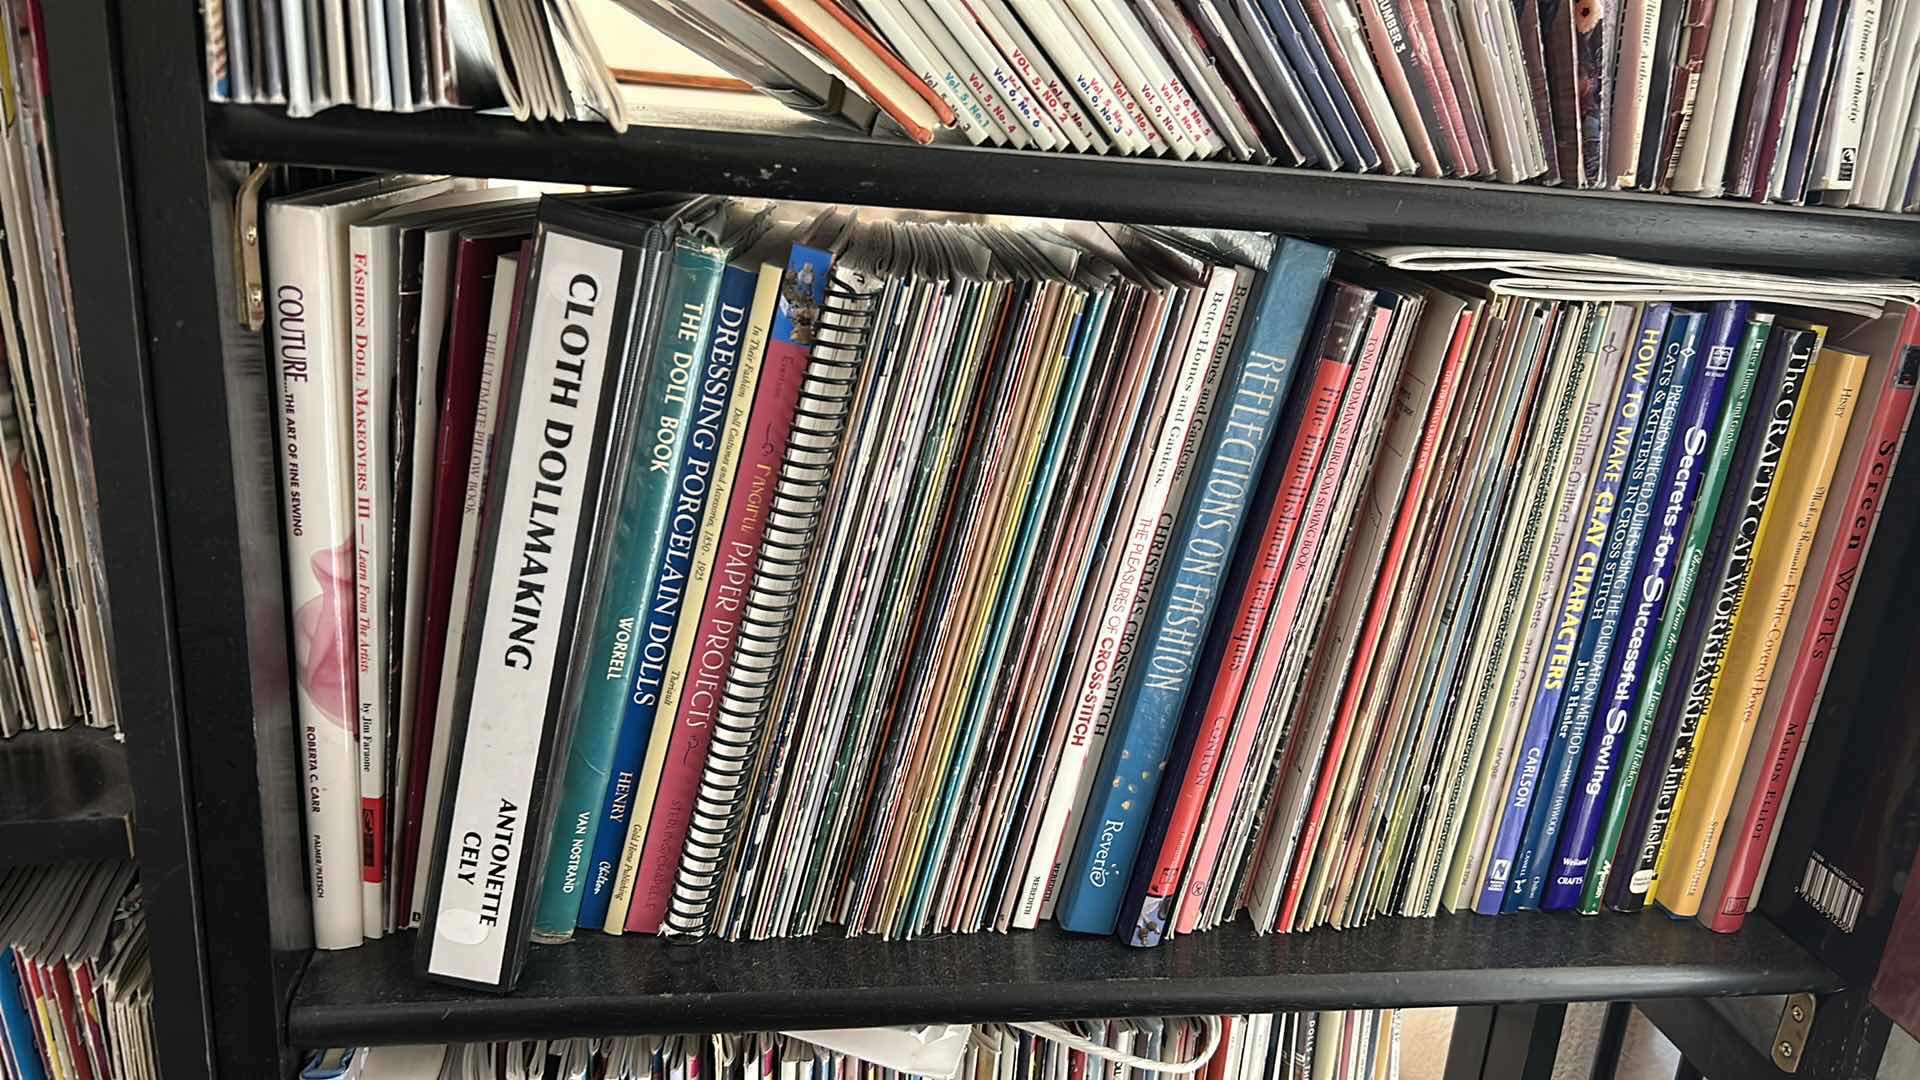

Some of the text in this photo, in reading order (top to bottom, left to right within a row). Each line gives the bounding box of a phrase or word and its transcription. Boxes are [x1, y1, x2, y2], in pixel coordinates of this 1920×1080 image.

[1394, 43, 1406, 53] 3
[1847, 9, 1874, 123] Ultimate Authority
[967, 72, 1017, 133] Vol. 5, No. 4
[991, 66, 1011, 89] Vol.
[1017, 99, 1034, 119] No.
[1011, 48, 1068, 122] VOL. 5, NO. 2
[1200, 290, 1224, 338] Better
[1223, 285, 1247, 332] Better
[648, 300, 704, 474] THE DOLL BOOK
[1183, 339, 1208, 392] Homes
[1205, 332, 1232, 386] Homes
[1780, 344, 1811, 397] The
[286, 417, 296, 436] ART
[1173, 395, 1191, 423] and
[1195, 387, 1214, 416] and
[288, 440, 298, 459] OF
[289, 463, 299, 487] FINE
[354, 253, 370, 672] FASHION DOLL MAKEOVERS III Learn From The Artists
[502, 272, 599, 672] CLOTH DOLLMAKING
[693, 325, 762, 581] In Their Fashion Doll Costumes and Accessories, 1925
[1295, 335, 1378, 571] TONIA TODMAN'S HEIRLOOM SEWING BOOK
[1745, 396, 1794, 512] CRAFTY
[631, 302, 745, 707] DRESSING PORCELAIN DOLLS
[1542, 326, 1661, 692] HOW TO MAKE CLAY CHARACTERS
[1590, 340, 1680, 622] CATS & KITTENS IN CROSS STITCH
[1798, 484, 1826, 530] Making
[290, 491, 302, 536] SEWING
[1143, 347, 1287, 696] REFLECTIONS ON FASHION
[1223, 383, 1340, 676] Fine Embellishment Techniques
[1729, 514, 1759, 569] CAT
[714, 539, 753, 613] PAPER
[1566, 383, 1683, 755] PRECISION PIECED QUILTS USING THE FOUNDATION METHOD
[1810, 438, 1896, 663] Screen Works
[1070, 516, 1151, 747] THE PLEASURES OF CROSS-STITCH
[1092, 511, 1173, 737] CHRISTMAS CROSS-STITCH
[1584, 424, 1708, 797] Secrets for Successful Sewing
[1751, 581, 1796, 684] Fabric-Covered
[605, 615, 634, 682] WORRELL
[684, 617, 733, 730] PROJECTS
[1623, 547, 1704, 788] Christmas from the Heart Home for the Holidays
[1677, 567, 1742, 744] WORKBASKET
[1556, 658, 1590, 739] Julie Hasler
[1740, 685, 1763, 724] Boxes
[306, 726, 317, 770] ROBERTA
[359, 702, 372, 772] by Jim Faraone
[309, 774, 318, 783] C.
[310, 786, 320, 812] CARR
[608, 770, 633, 824] HENRY
[1512, 746, 1541, 808] CARLSON
[1656, 762, 1682, 807] Julie
[1750, 721, 1799, 842] MARION ELLIOT
[456, 830, 482, 885] CELY
[478, 797, 518, 928] ANTONETTE
[561, 810, 589, 894] VAN NOSTRAND
[629, 823, 642, 842] Gold
[1640, 807, 1668, 864] Hasler
[592, 860, 611, 896] Chilton
[614, 863, 632, 901] Publishing
[1557, 876, 1582, 884] CRAFTS
[1305, 1019, 1315, 1052] DOLLS
